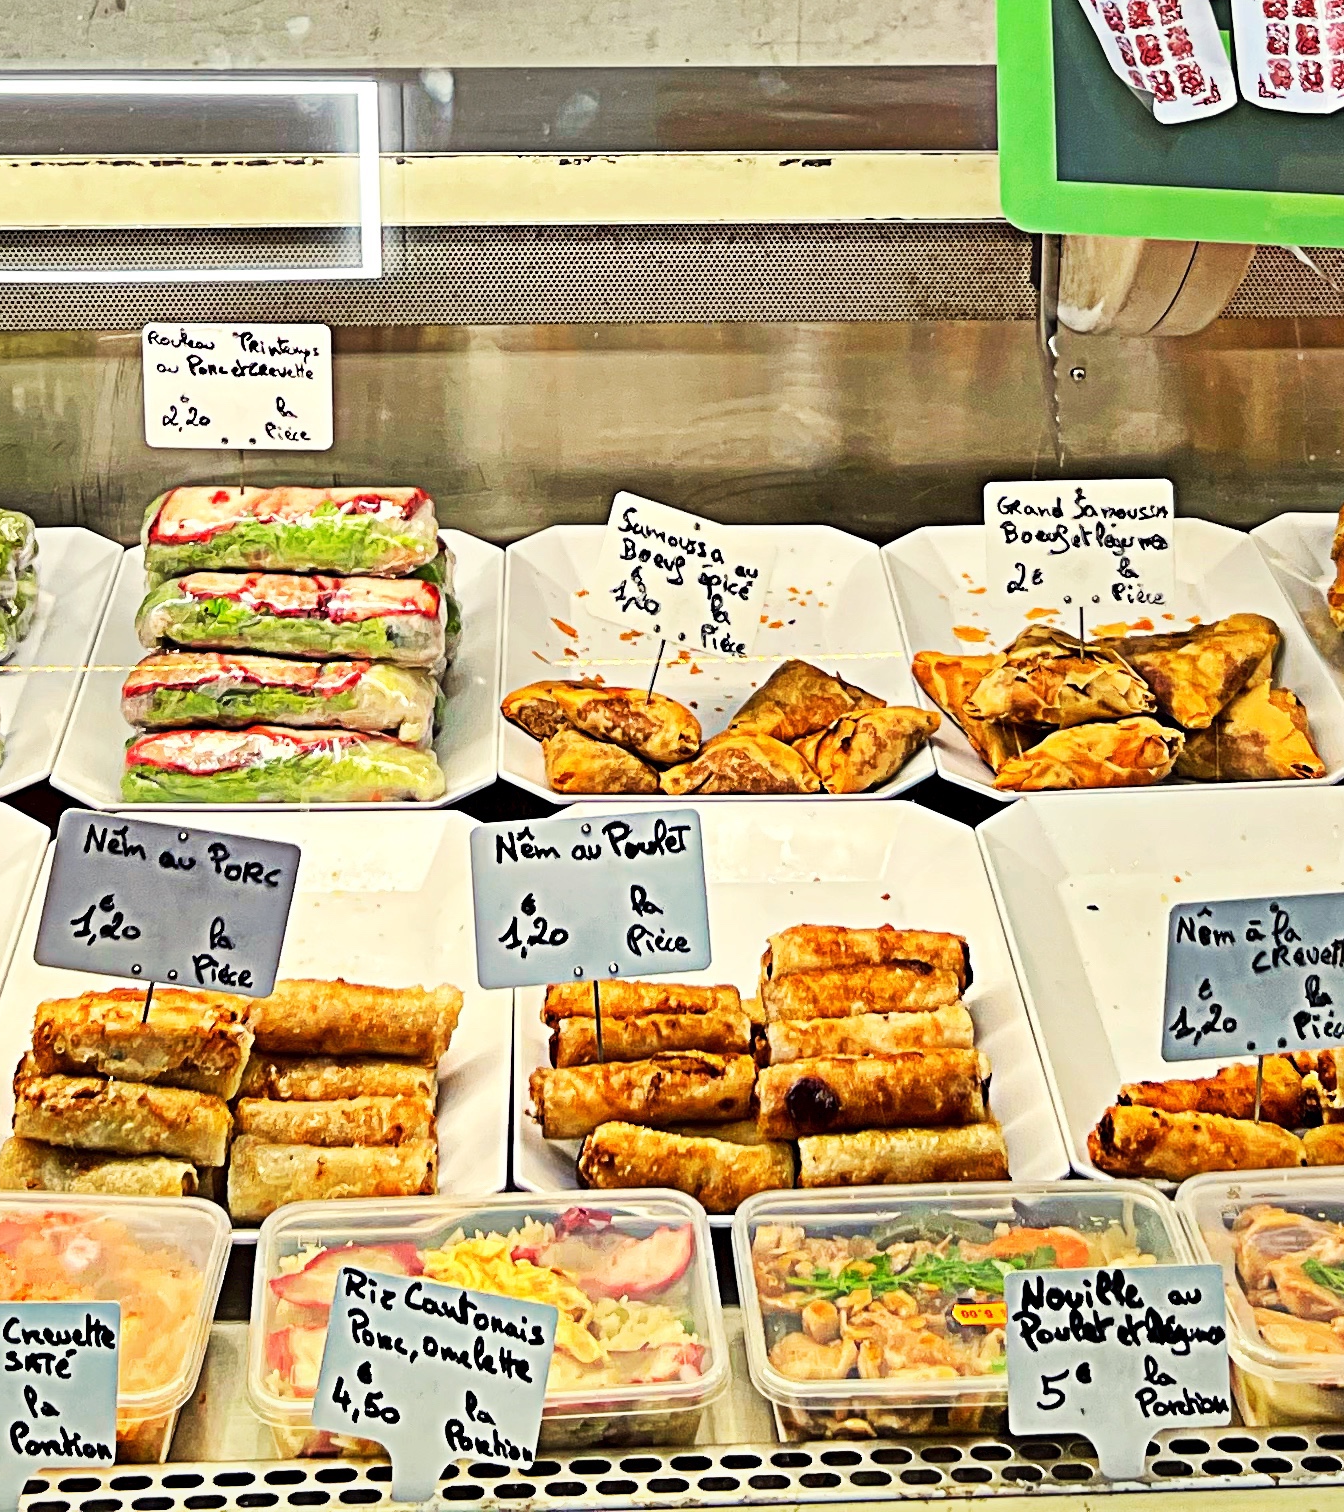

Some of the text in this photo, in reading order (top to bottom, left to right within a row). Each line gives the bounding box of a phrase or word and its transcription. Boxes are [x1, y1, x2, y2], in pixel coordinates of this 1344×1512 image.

[496, 826, 560, 864] Nêm
[572, 844, 602, 860] au
[159, 851, 196, 870] au
[342, 1267, 545, 1345] Riz Cantonais
[1168, 1289, 1202, 1305] au
